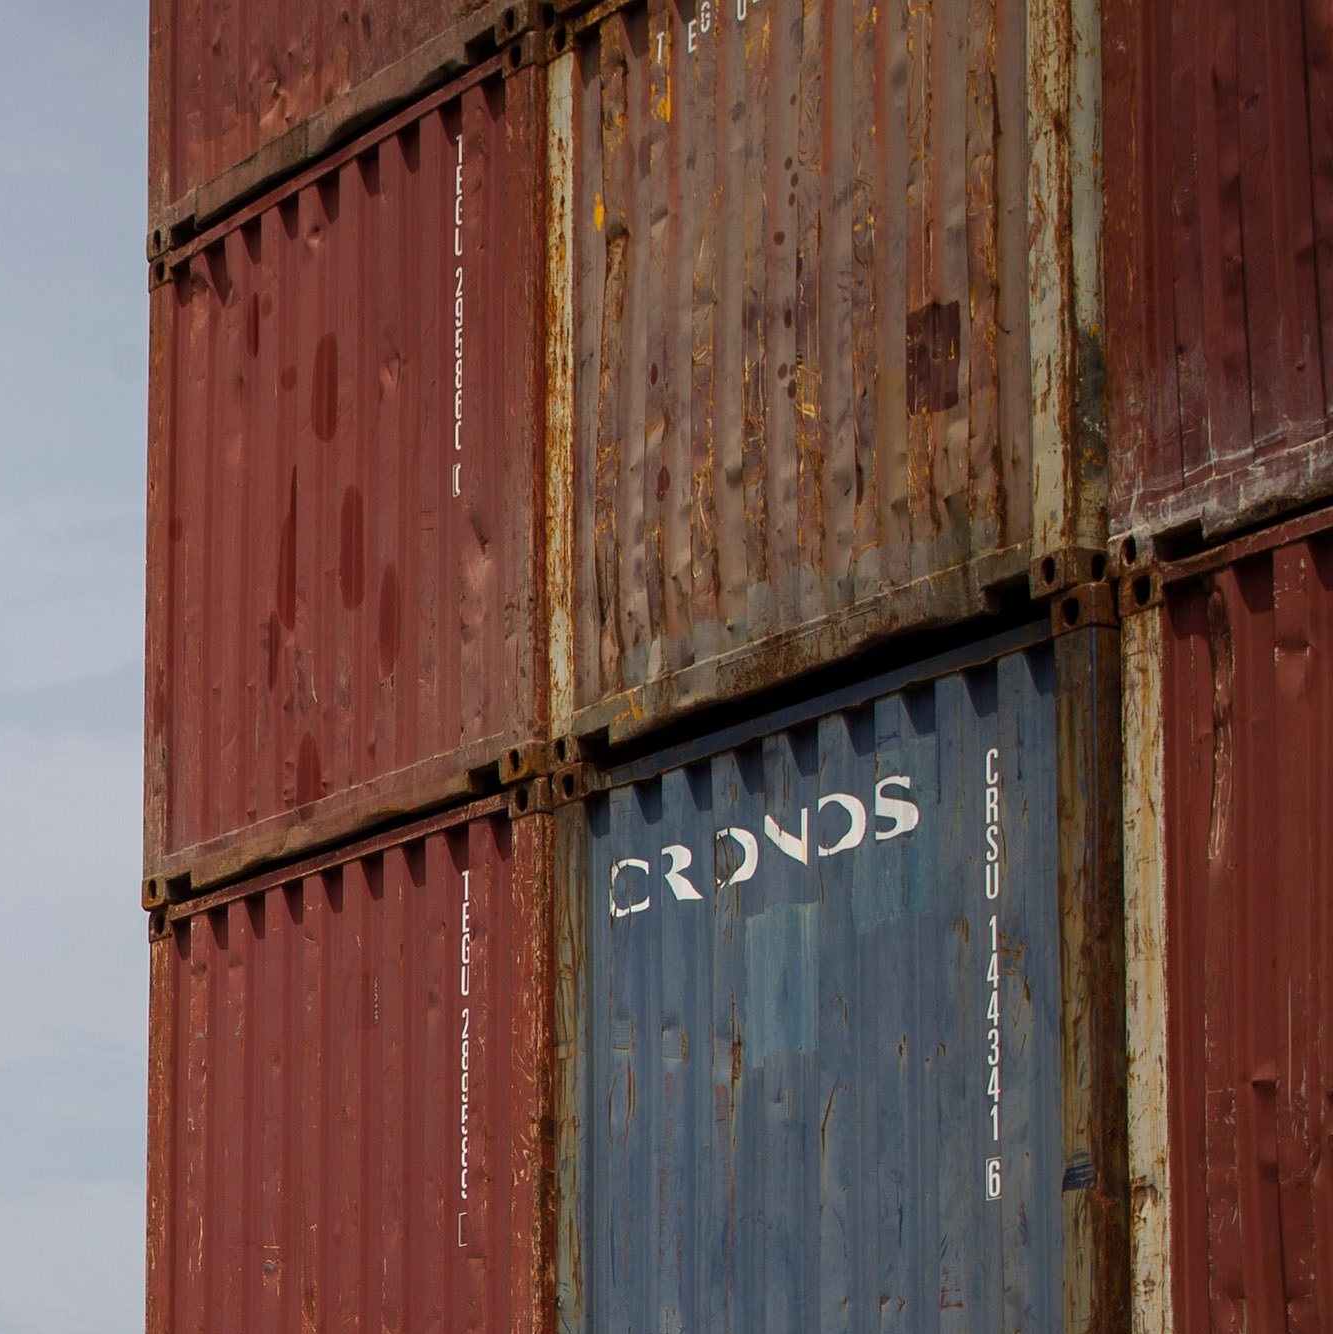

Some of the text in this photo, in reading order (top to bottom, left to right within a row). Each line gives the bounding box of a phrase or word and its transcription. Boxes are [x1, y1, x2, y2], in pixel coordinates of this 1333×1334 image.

[985, 748, 1002, 1200] CRSU 144341 6
